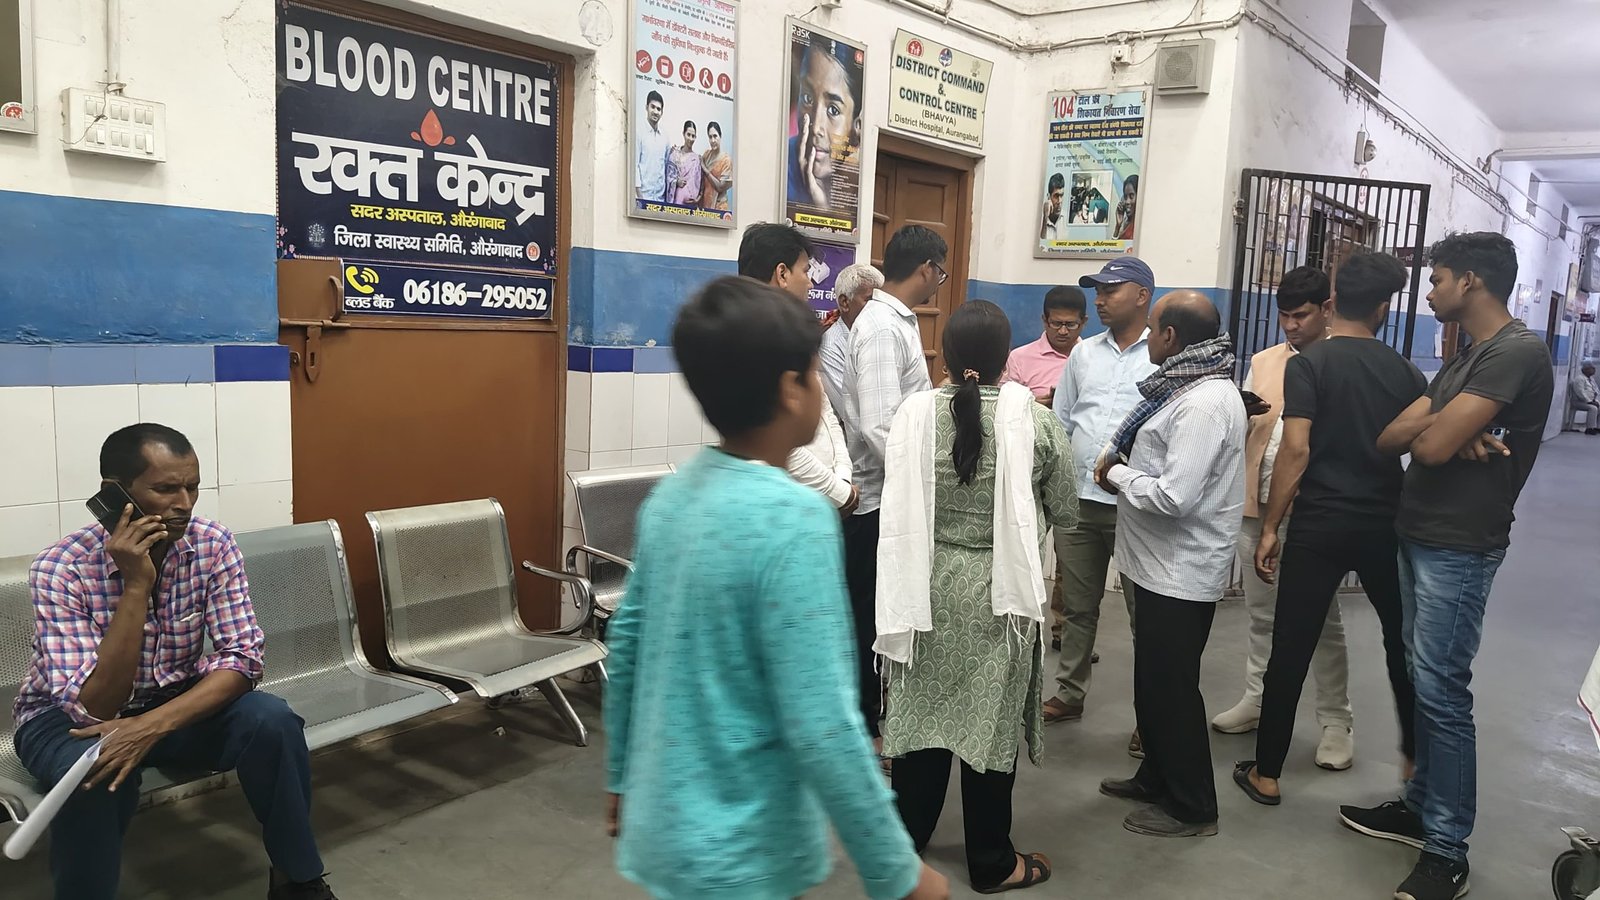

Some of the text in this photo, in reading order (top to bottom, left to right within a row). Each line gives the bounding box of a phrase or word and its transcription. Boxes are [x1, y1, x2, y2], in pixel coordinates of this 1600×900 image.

[285, 23, 550, 127] BLOOD CENTRE
[896, 55, 985, 94] DISTRICT COMMAND
[899, 87, 977, 120] CONTROL CENTRE
[921, 109, 957, 127] (BHAVYA)
[1077, 107, 1101, 119] शिकायत
[1128, 104, 1141, 115] सेवा
[894, 113, 979, 143] District Hospital, Aurangabad
[291, 131, 550, 226] रक्त केन्द्र
[350, 204, 507, 230] सदर अस्पताल, औरंगाबाद
[333, 224, 524, 259] जिला स्वास्थ्य समिति, औरंगाबाद
[345, 293, 395, 309] ब्लड बैंक
